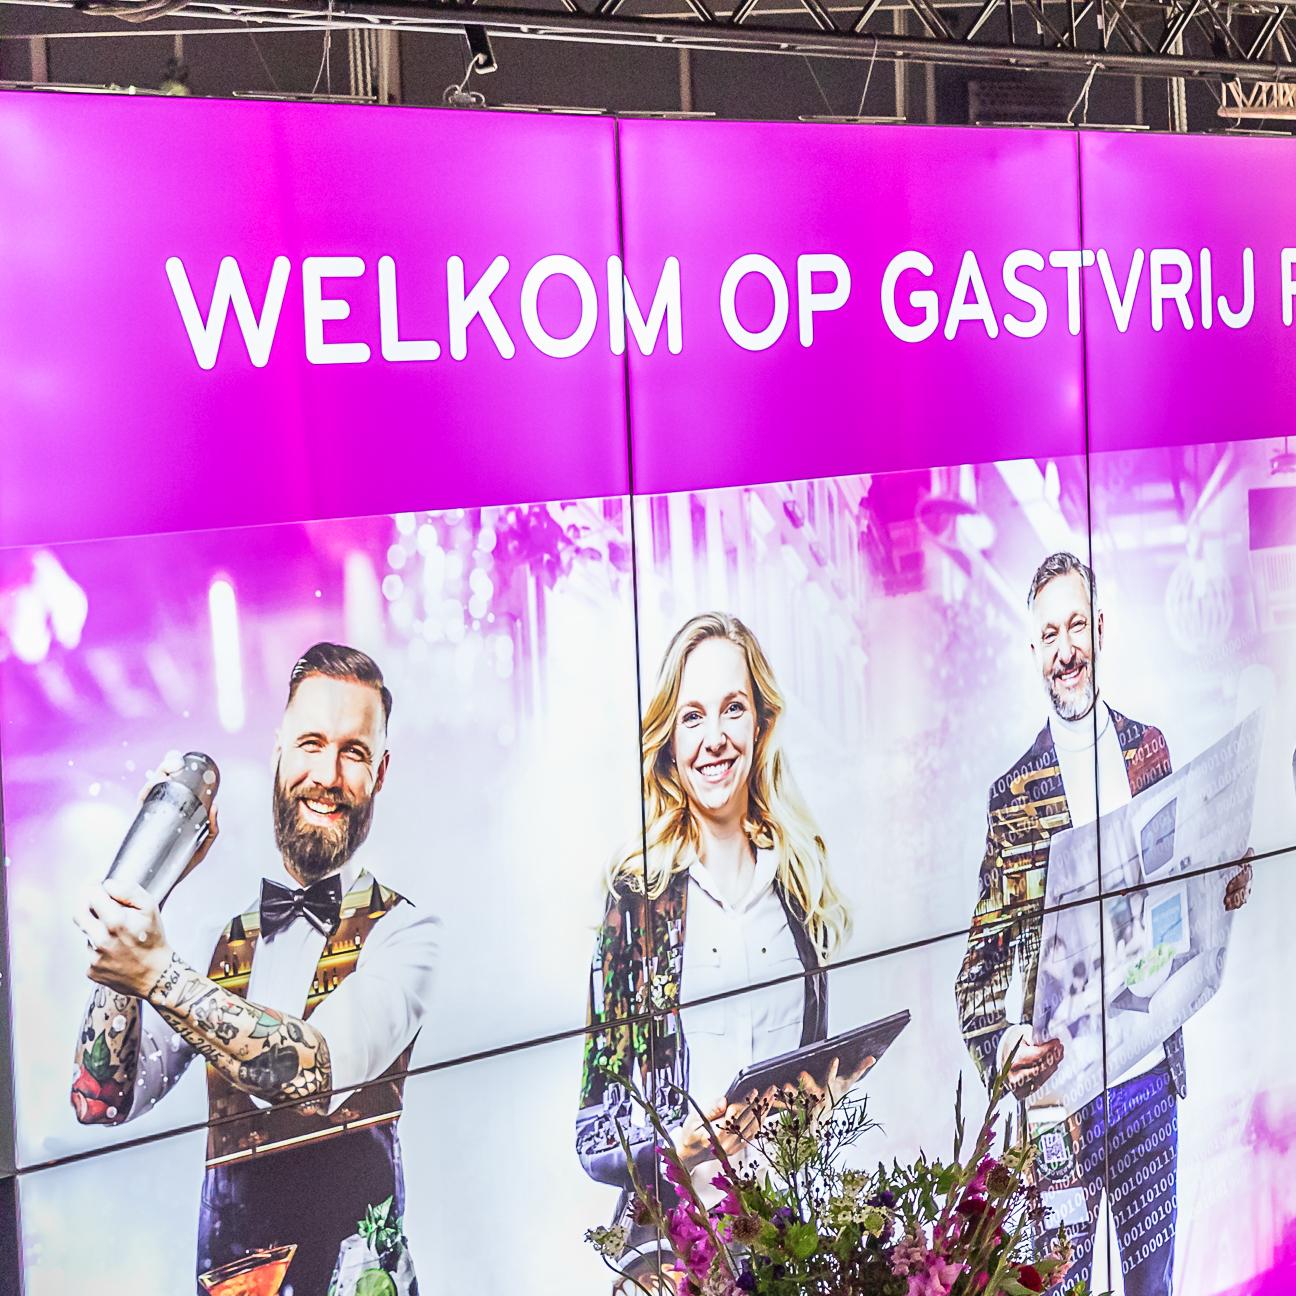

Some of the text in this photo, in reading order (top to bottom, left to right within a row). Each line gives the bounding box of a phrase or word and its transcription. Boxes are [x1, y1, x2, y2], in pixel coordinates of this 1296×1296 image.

[164, 253, 685, 371] WELKOM
[718, 252, 853, 353] OP
[880, 246, 1257, 345] GASTVRIJ
